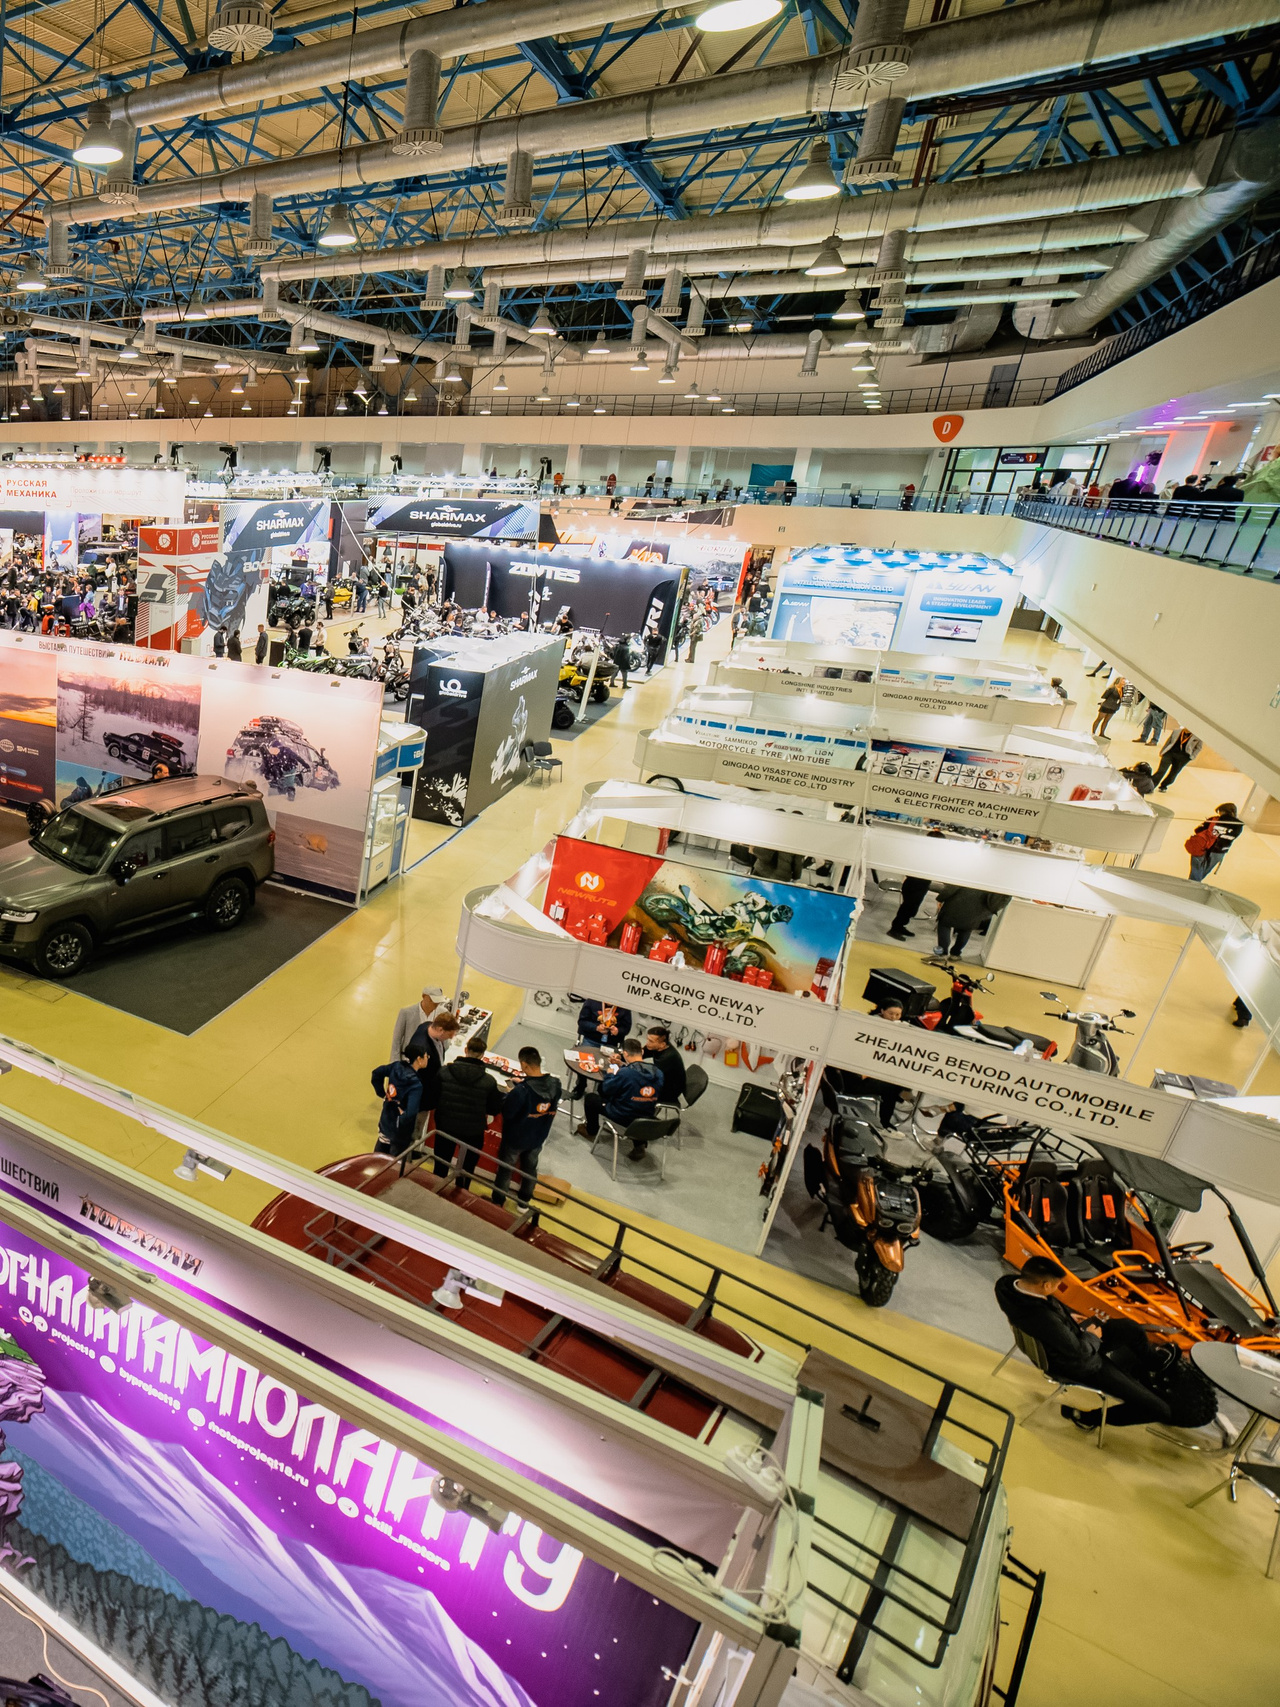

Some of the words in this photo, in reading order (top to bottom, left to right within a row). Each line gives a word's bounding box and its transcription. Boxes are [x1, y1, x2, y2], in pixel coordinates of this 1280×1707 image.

[941, 421, 952, 435] D
[6, 479, 48, 488] РУССКАЯ
[6, 489, 58, 499] МЕХАНИКА
[256, 517, 305, 531] SHARMAX
[409, 510, 487, 523] SHARMAX
[509, 668, 538, 692] SHARMAX
[781, 680, 815, 689] LONGSHINE
[816, 684, 853, 694] INDUSTRIES
[882, 692, 913, 701] QINGDAO
[914, 696, 964, 707] RUNTONGMAO
[965, 702, 989, 710] TRADE
[699, 739, 756, 755] MOTORCYCLE
[761, 749, 782, 759] TYRE
[806, 755, 831, 766] TUBE
[722, 759, 760, 772] QINGDAO
[762, 765, 810, 780] VISASTONE
[811, 773, 855, 788] INDUSTRY
[744, 770, 762, 780] AND
[764, 773, 792, 785] TRADE
[871, 784, 930, 800] CHONGQING
[931, 794, 975, 807] FIGHTER
[977, 801, 1040, 818] MACHINERY
[903, 798, 966, 815] ELECTRONIC
[621, 970, 706, 1001] CHONGQING
[709, 993, 765, 1017] NEWAY
[626, 984, 693, 1012] IMP.&EXP.
[697, 1004, 758, 1029] CO.,LTD.
[853, 1031, 941, 1063] ZHEJIANG
[944, 1055, 1013, 1083] BENOD
[1014, 1075, 1156, 1123] AUTOMOBILE
[871, 1050, 1030, 1104] MANUFACTURING
[1033, 1096, 1120, 1129] CO.,LTD.
[79, 1196, 206, 1278] ПОЕХАЛИ
[363, 1514, 451, 1572] skill_motors
